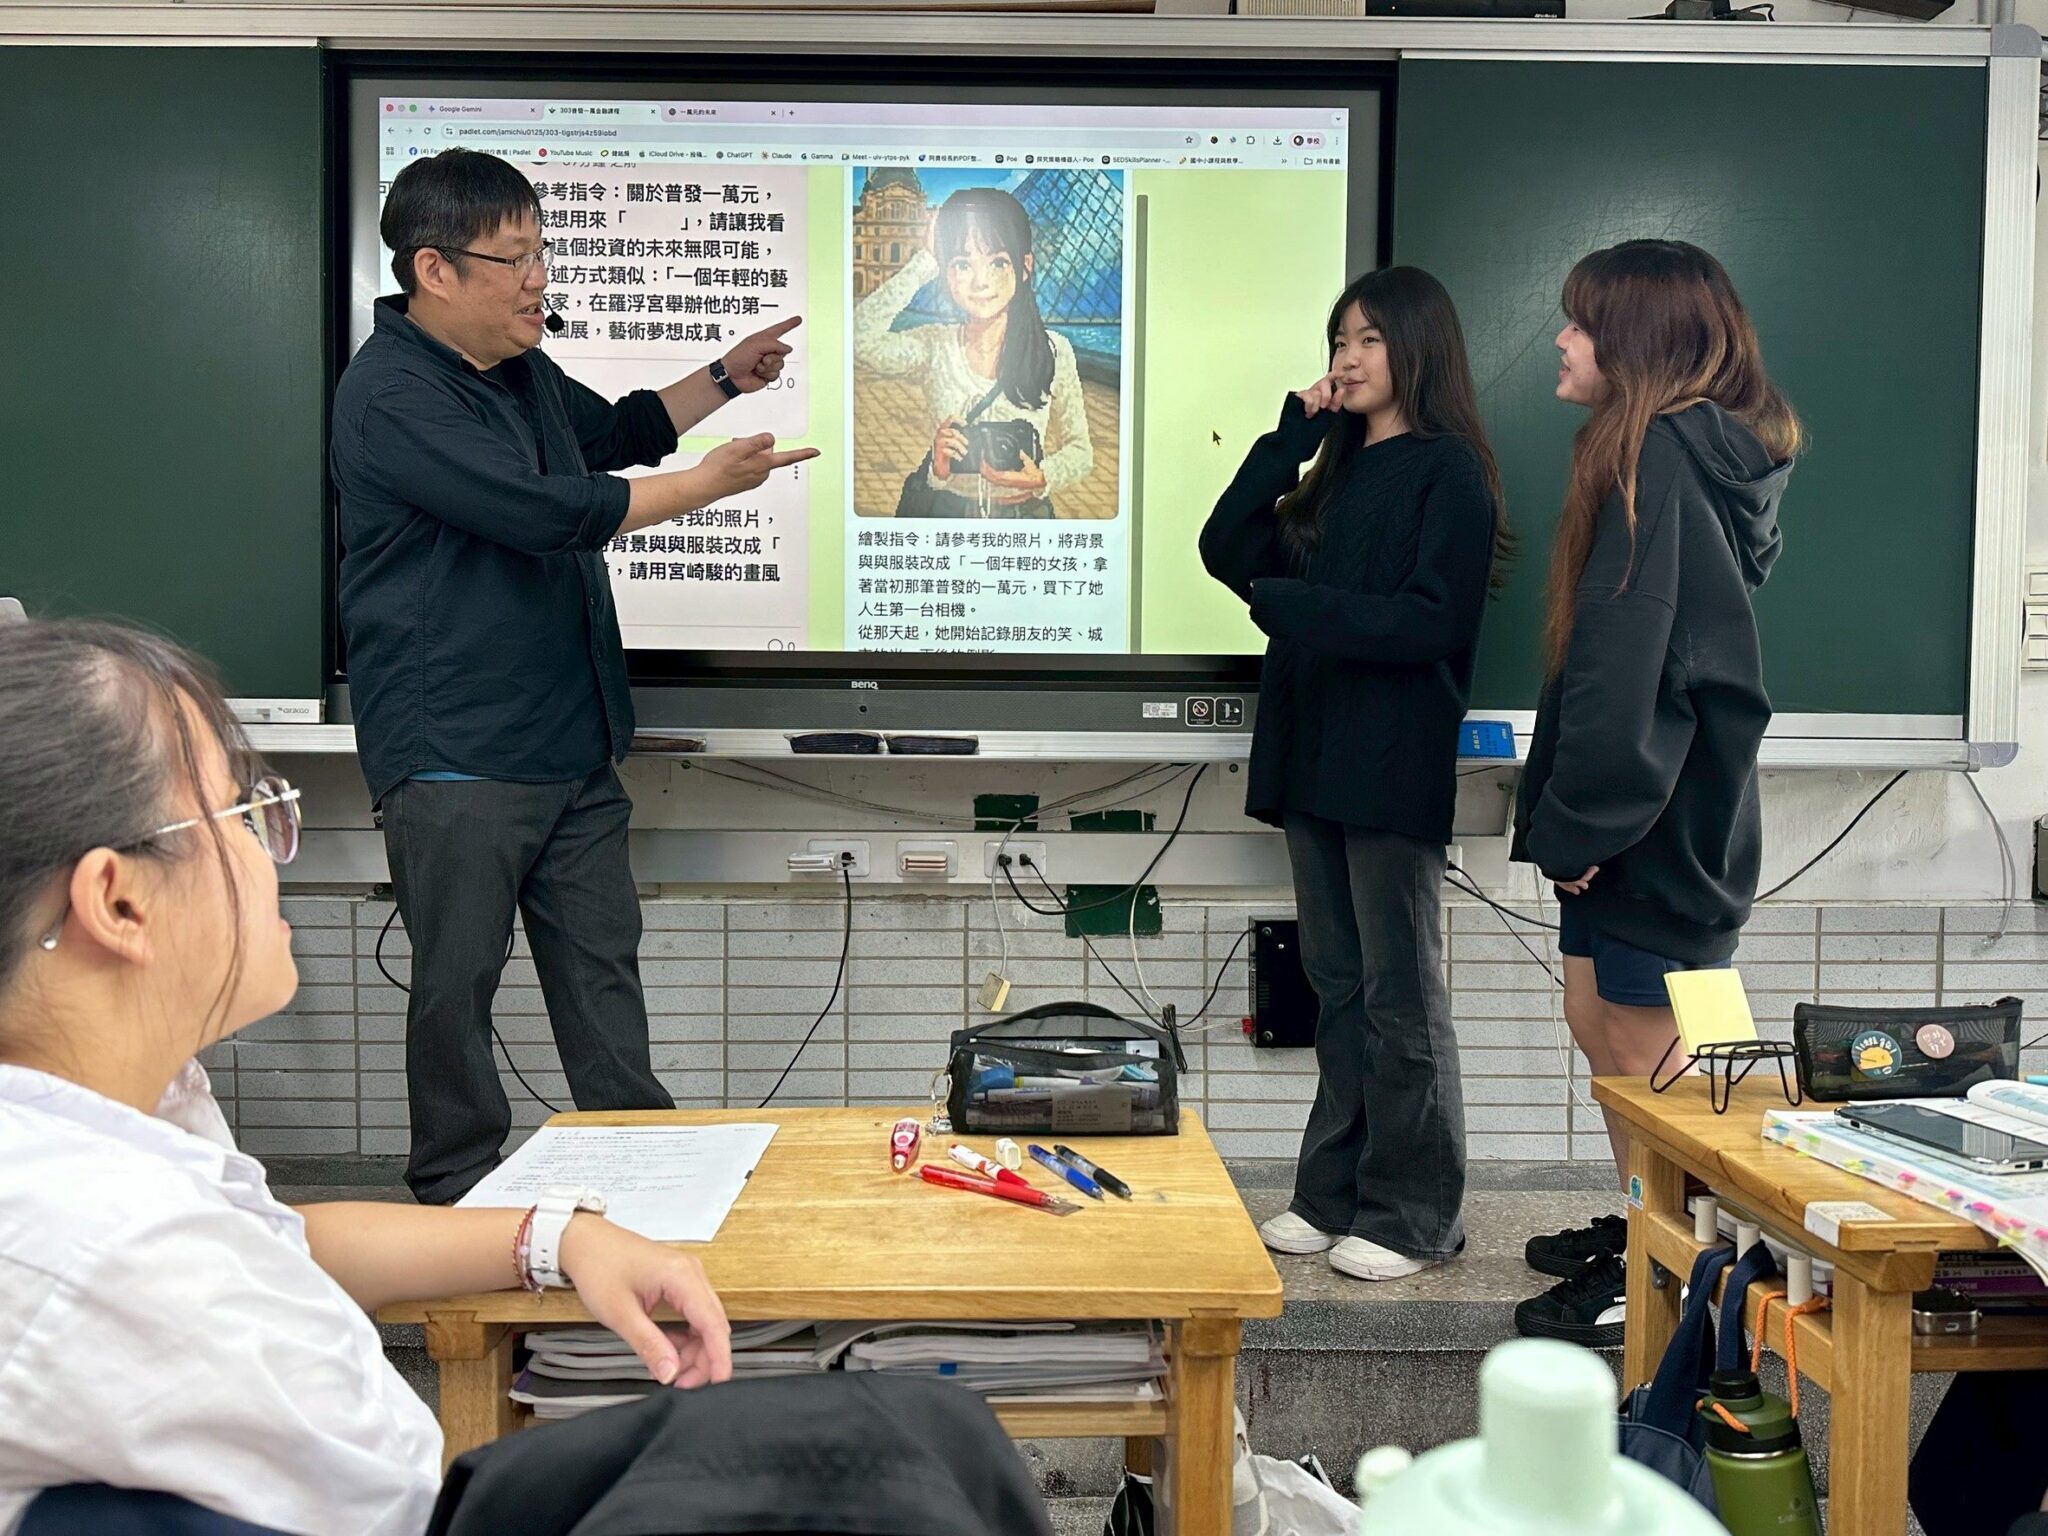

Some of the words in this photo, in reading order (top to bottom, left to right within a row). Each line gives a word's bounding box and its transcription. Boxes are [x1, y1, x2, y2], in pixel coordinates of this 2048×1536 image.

[439, 106, 461, 114] Google
[461, 105, 483, 113] Gemini
[858, 531, 1104, 549] 繪製指令：請參考我的照片，將背景
[858, 578, 1104, 596] 著當初那筆普發的一萬元，買下了她
[858, 602, 977, 618] 人生第一台相機。
[858, 624, 1104, 642] 從那天起，她開始記錄朋友的笑、城
[851, 680, 879, 690] BenQ
